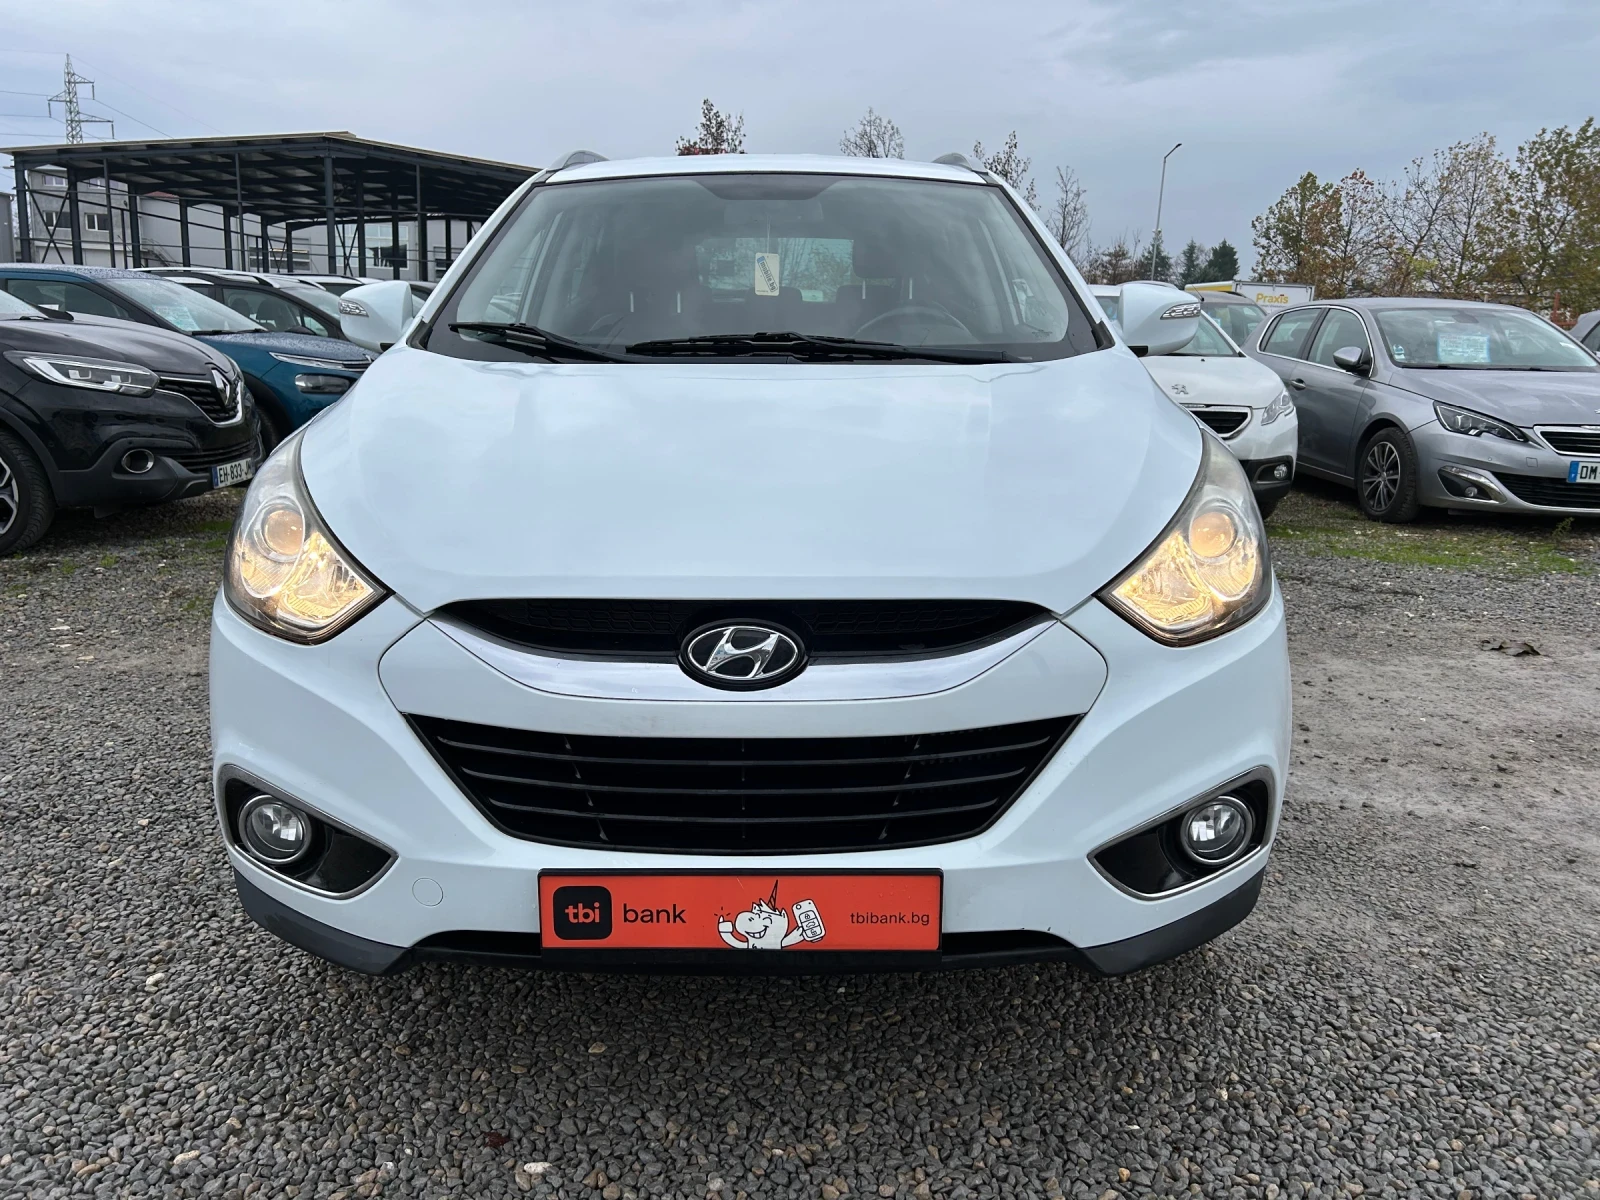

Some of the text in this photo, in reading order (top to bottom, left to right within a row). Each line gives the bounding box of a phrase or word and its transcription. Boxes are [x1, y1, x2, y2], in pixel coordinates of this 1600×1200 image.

[1255, 292, 1289, 304] Praxis
[565, 902, 687, 924] tbi bank
[850, 911, 930, 926] tbibank.bg
